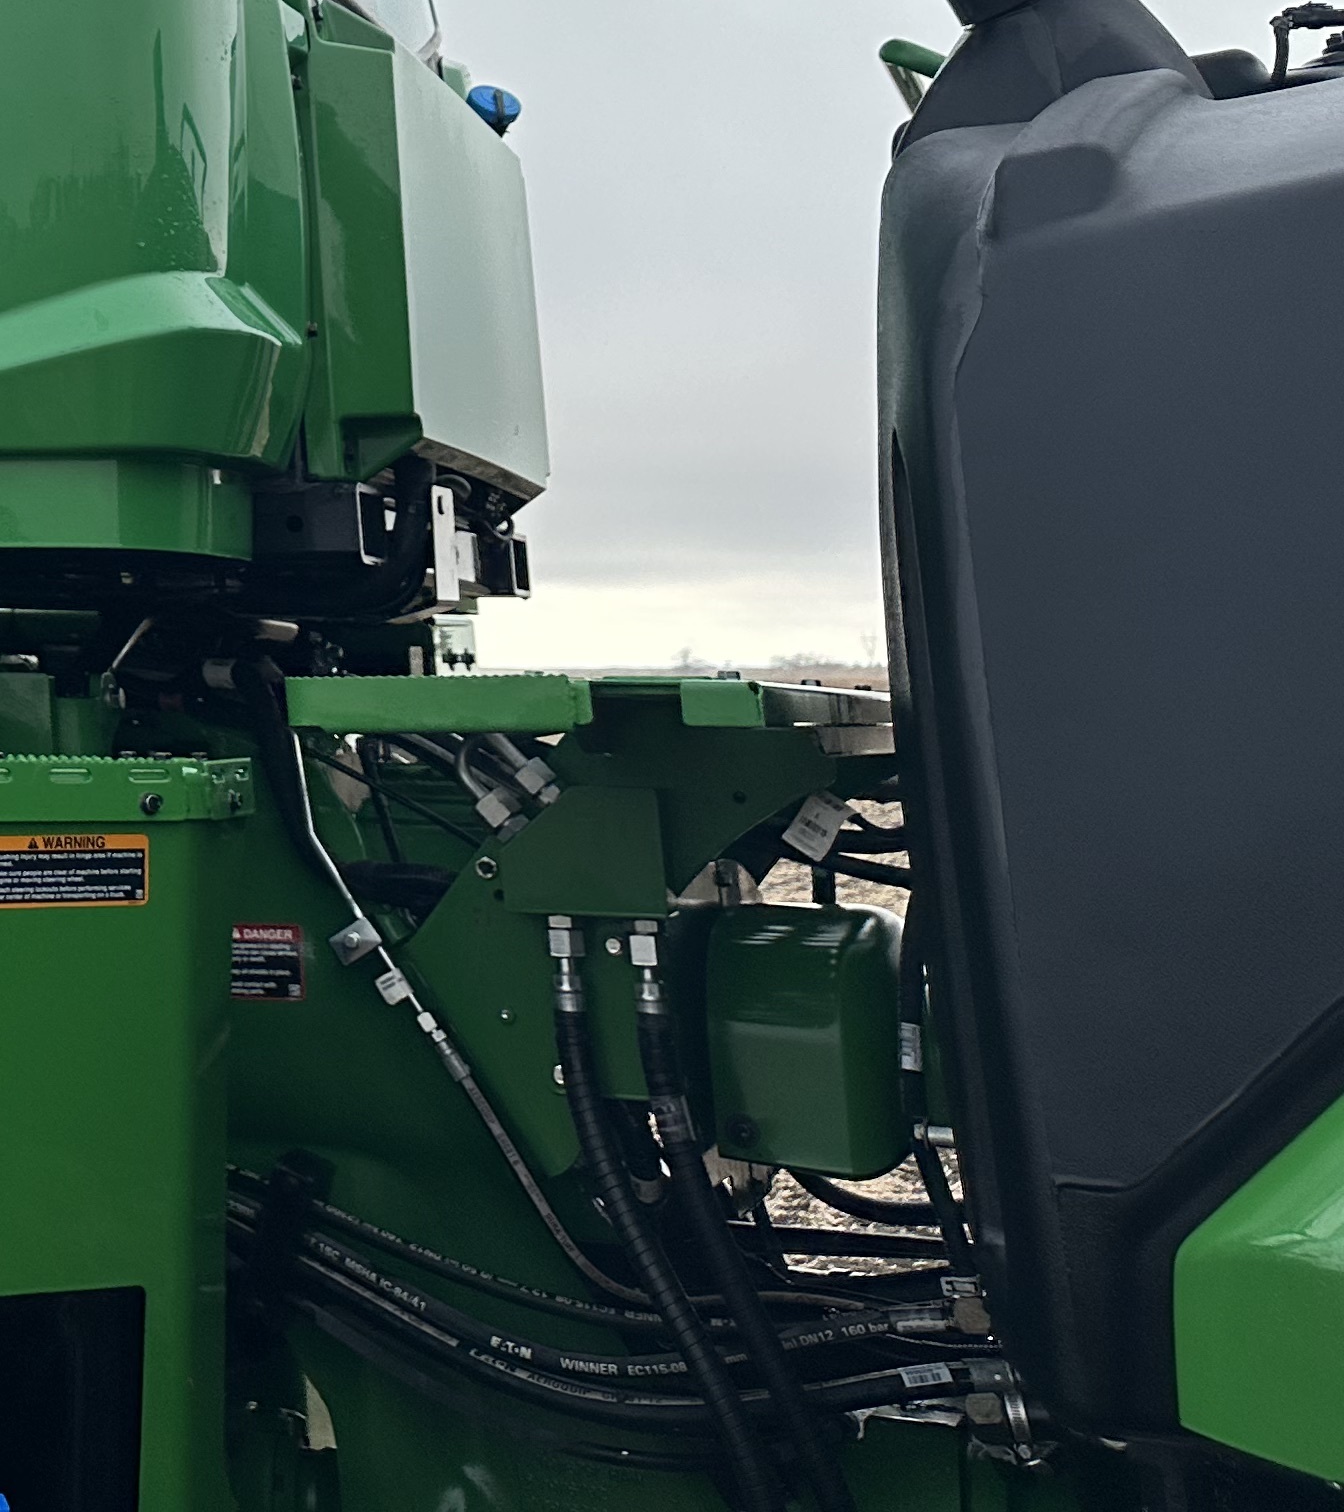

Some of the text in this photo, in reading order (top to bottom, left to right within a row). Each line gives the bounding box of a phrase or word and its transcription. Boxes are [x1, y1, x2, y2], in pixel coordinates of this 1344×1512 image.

[42, 836, 106, 849] WARNING
[243, 928, 293, 940] DANGER
[798, 1329, 834, 1348] DN12
[840, 1325, 866, 1338] 160
[867, 1321, 890, 1334] bar
[559, 1357, 619, 1376] WINNER
